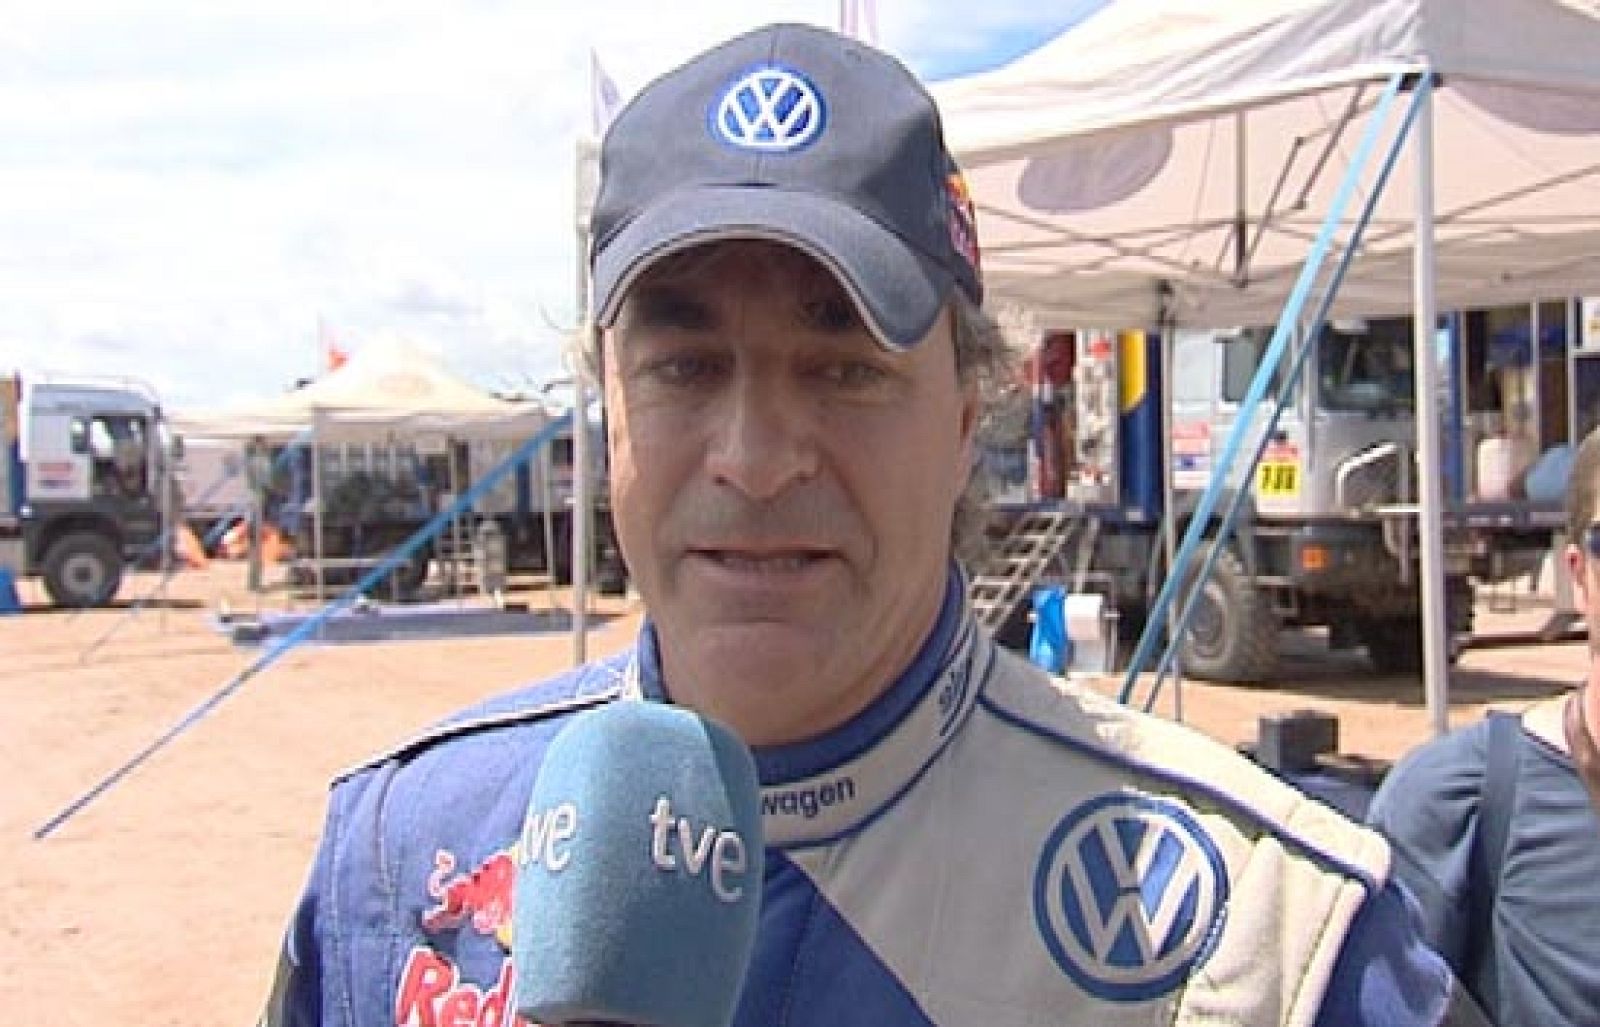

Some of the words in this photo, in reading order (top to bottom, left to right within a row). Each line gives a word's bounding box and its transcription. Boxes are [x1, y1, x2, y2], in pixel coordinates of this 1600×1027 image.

[717, 69, 819, 147] VW
[649, 796, 746, 902] tve
[1045, 803, 1215, 985] VW
